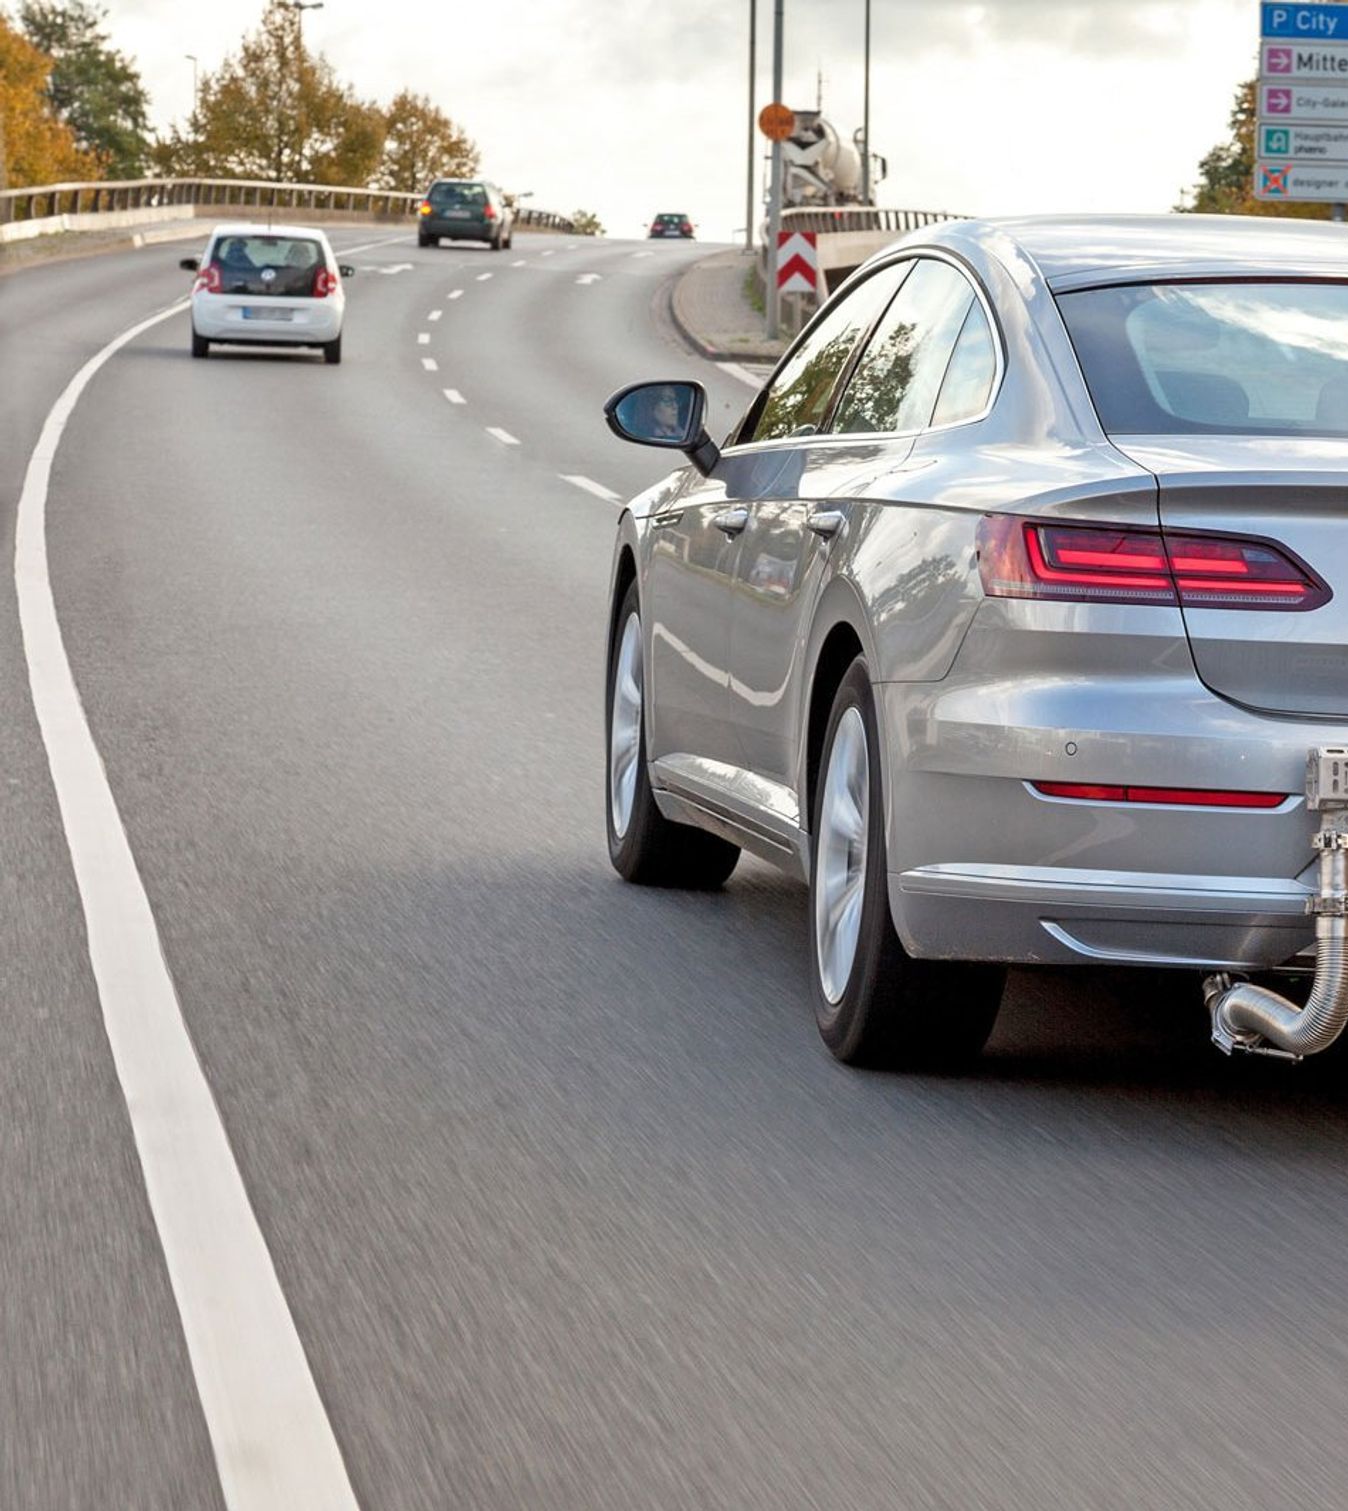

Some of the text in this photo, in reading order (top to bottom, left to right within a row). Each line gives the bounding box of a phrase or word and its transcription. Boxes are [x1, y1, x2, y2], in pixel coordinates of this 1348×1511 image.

[1273, 10, 1338, 35] P City
[1297, 53, 1348, 72] Mitte
[1293, 178, 1339, 189] designer
